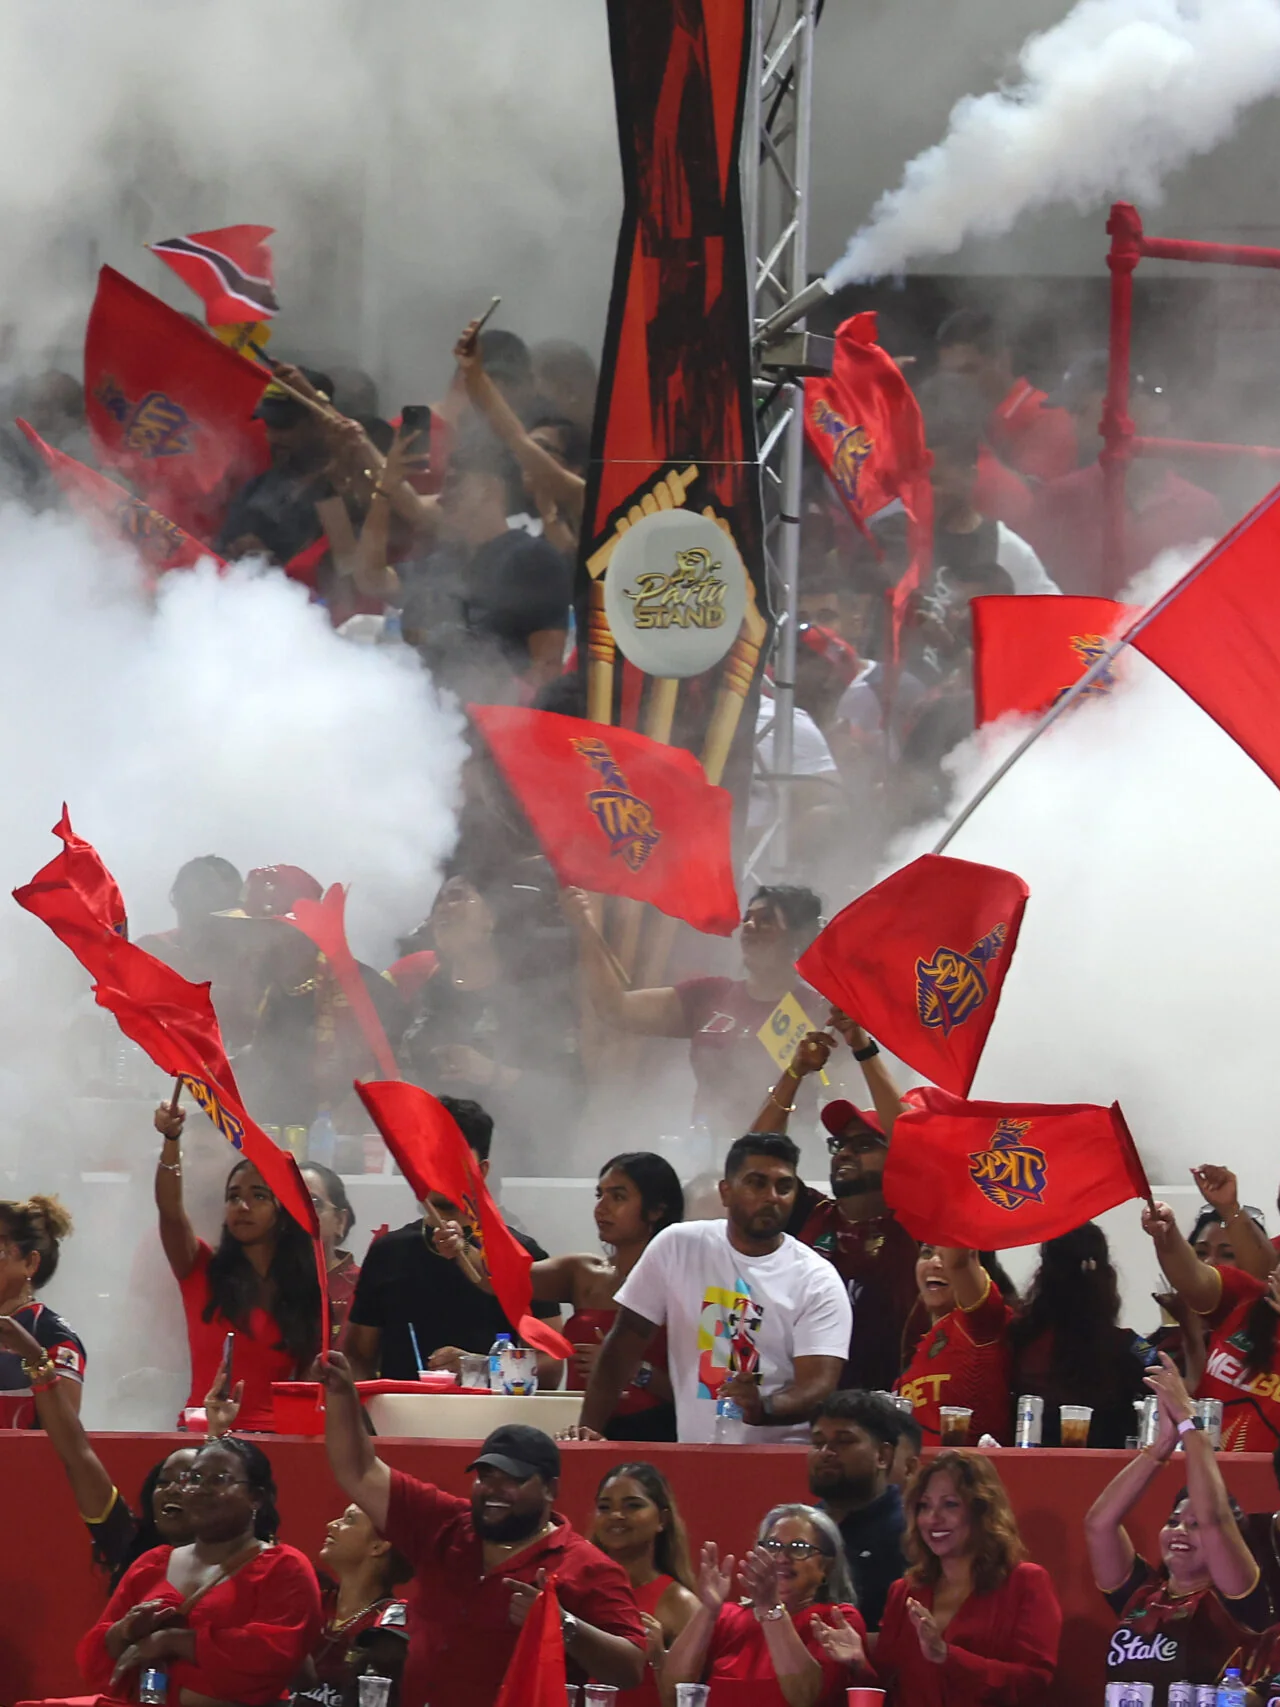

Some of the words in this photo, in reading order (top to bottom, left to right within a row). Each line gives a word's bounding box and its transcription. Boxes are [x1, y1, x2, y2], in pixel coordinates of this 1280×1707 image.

[622, 572, 728, 606] Party
[633, 605, 727, 630] STAND
[771, 1008, 791, 1037] 6
[899, 1373, 952, 1409] BET
[1107, 1628, 1178, 1667] Stake
